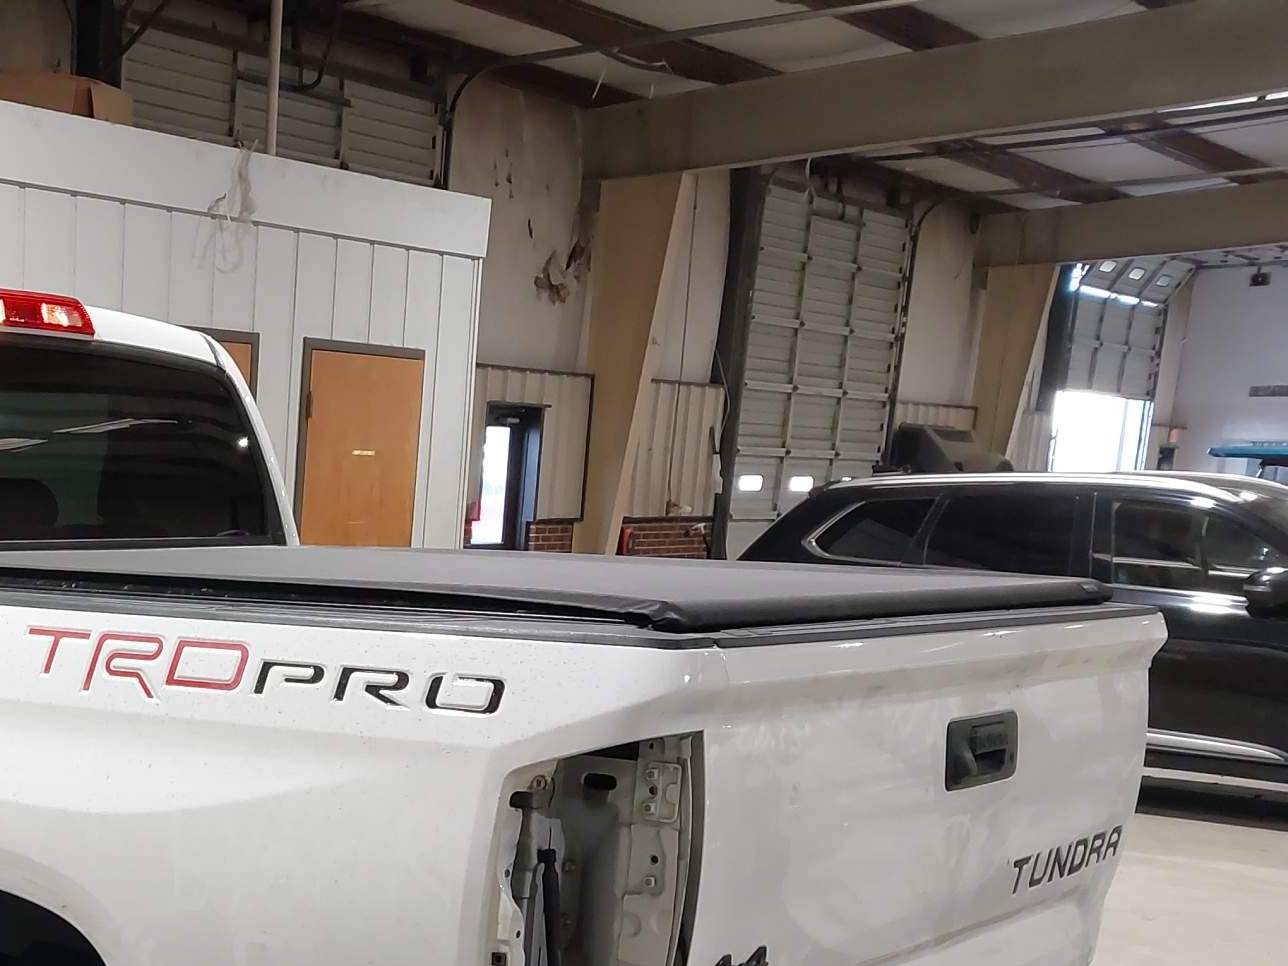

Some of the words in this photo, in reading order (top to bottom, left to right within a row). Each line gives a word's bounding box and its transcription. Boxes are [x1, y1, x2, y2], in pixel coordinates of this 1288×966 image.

[27, 626, 250, 700] TRD
[253, 659, 507, 716] PRO
[1012, 825, 1123, 895] TUNDRA
